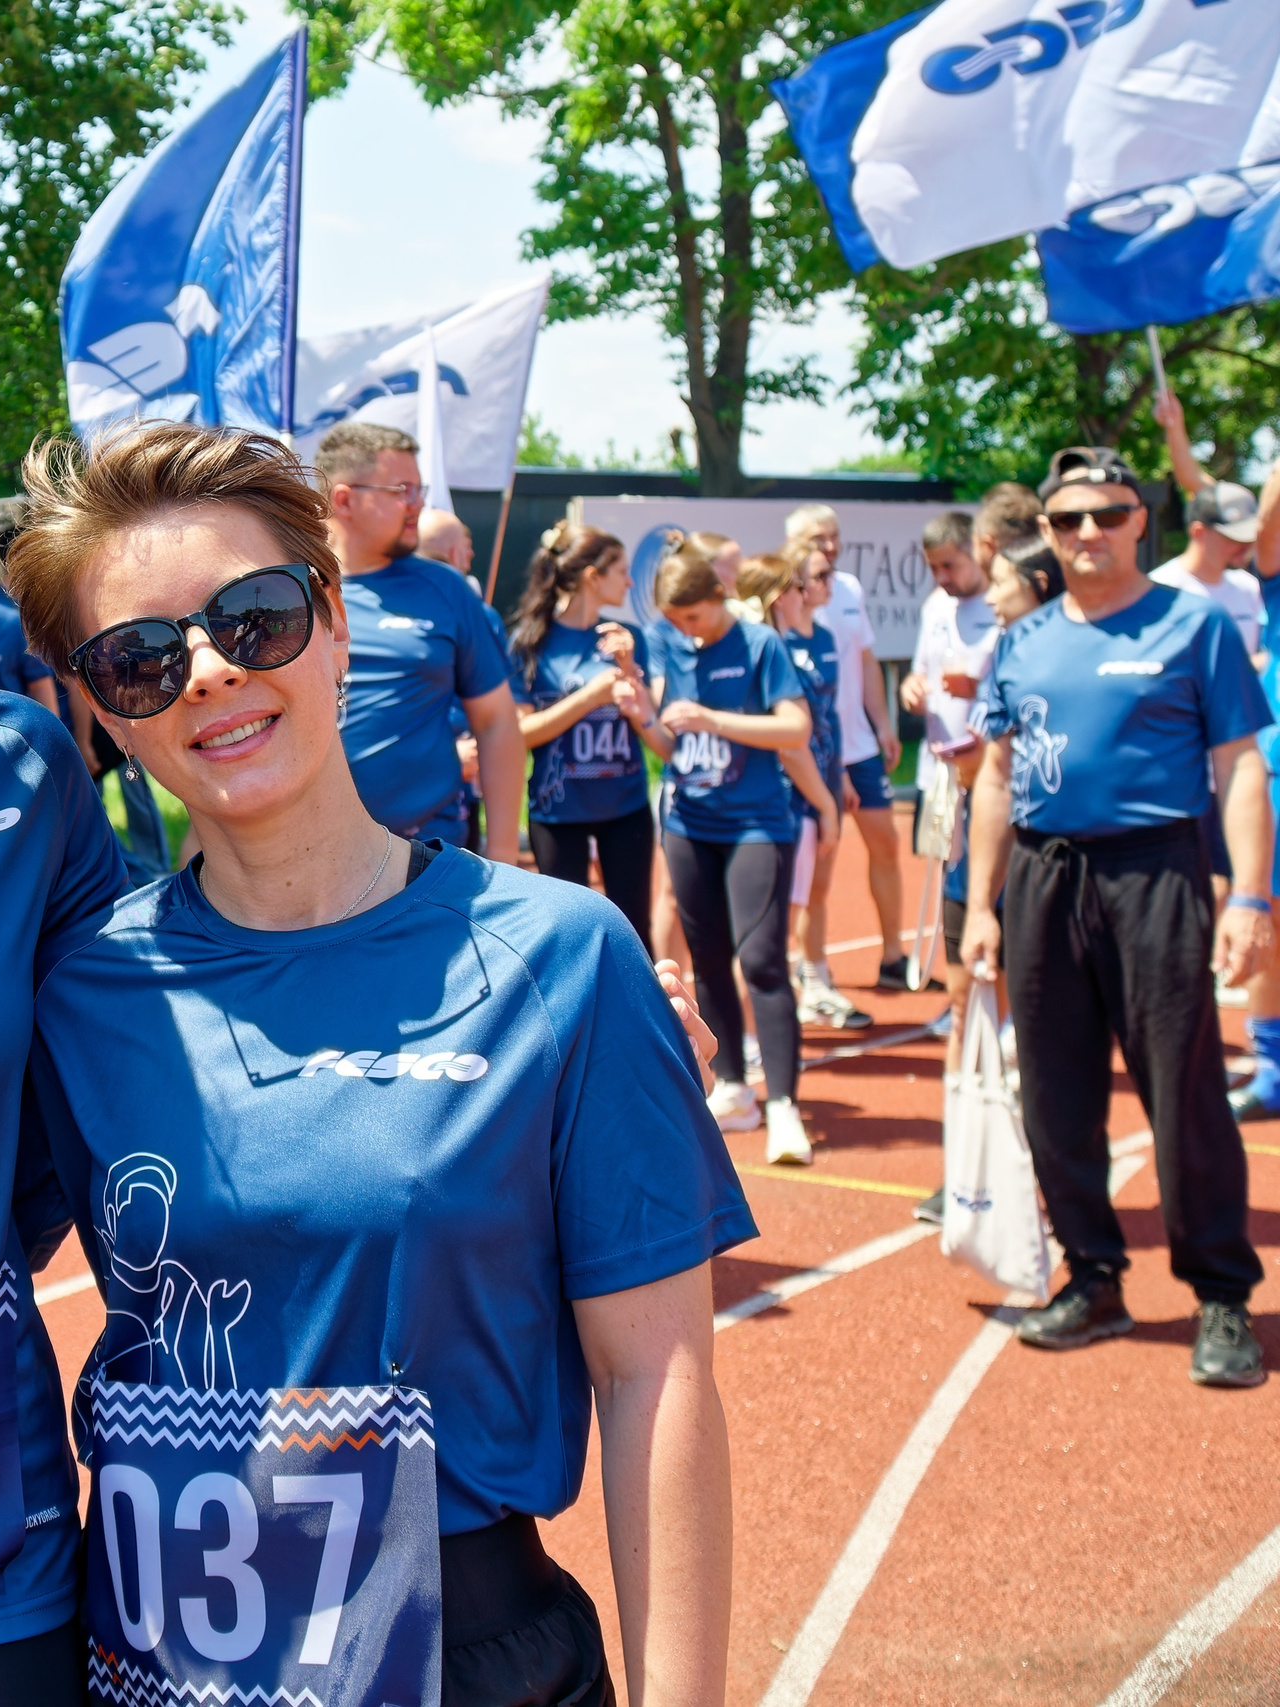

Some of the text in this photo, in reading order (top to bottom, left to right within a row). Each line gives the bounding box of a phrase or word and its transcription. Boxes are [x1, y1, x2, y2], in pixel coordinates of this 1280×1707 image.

[572, 720, 631, 763] 044
[297, 1050, 488, 1082] FESCO
[99, 1464, 365, 1665] 037
